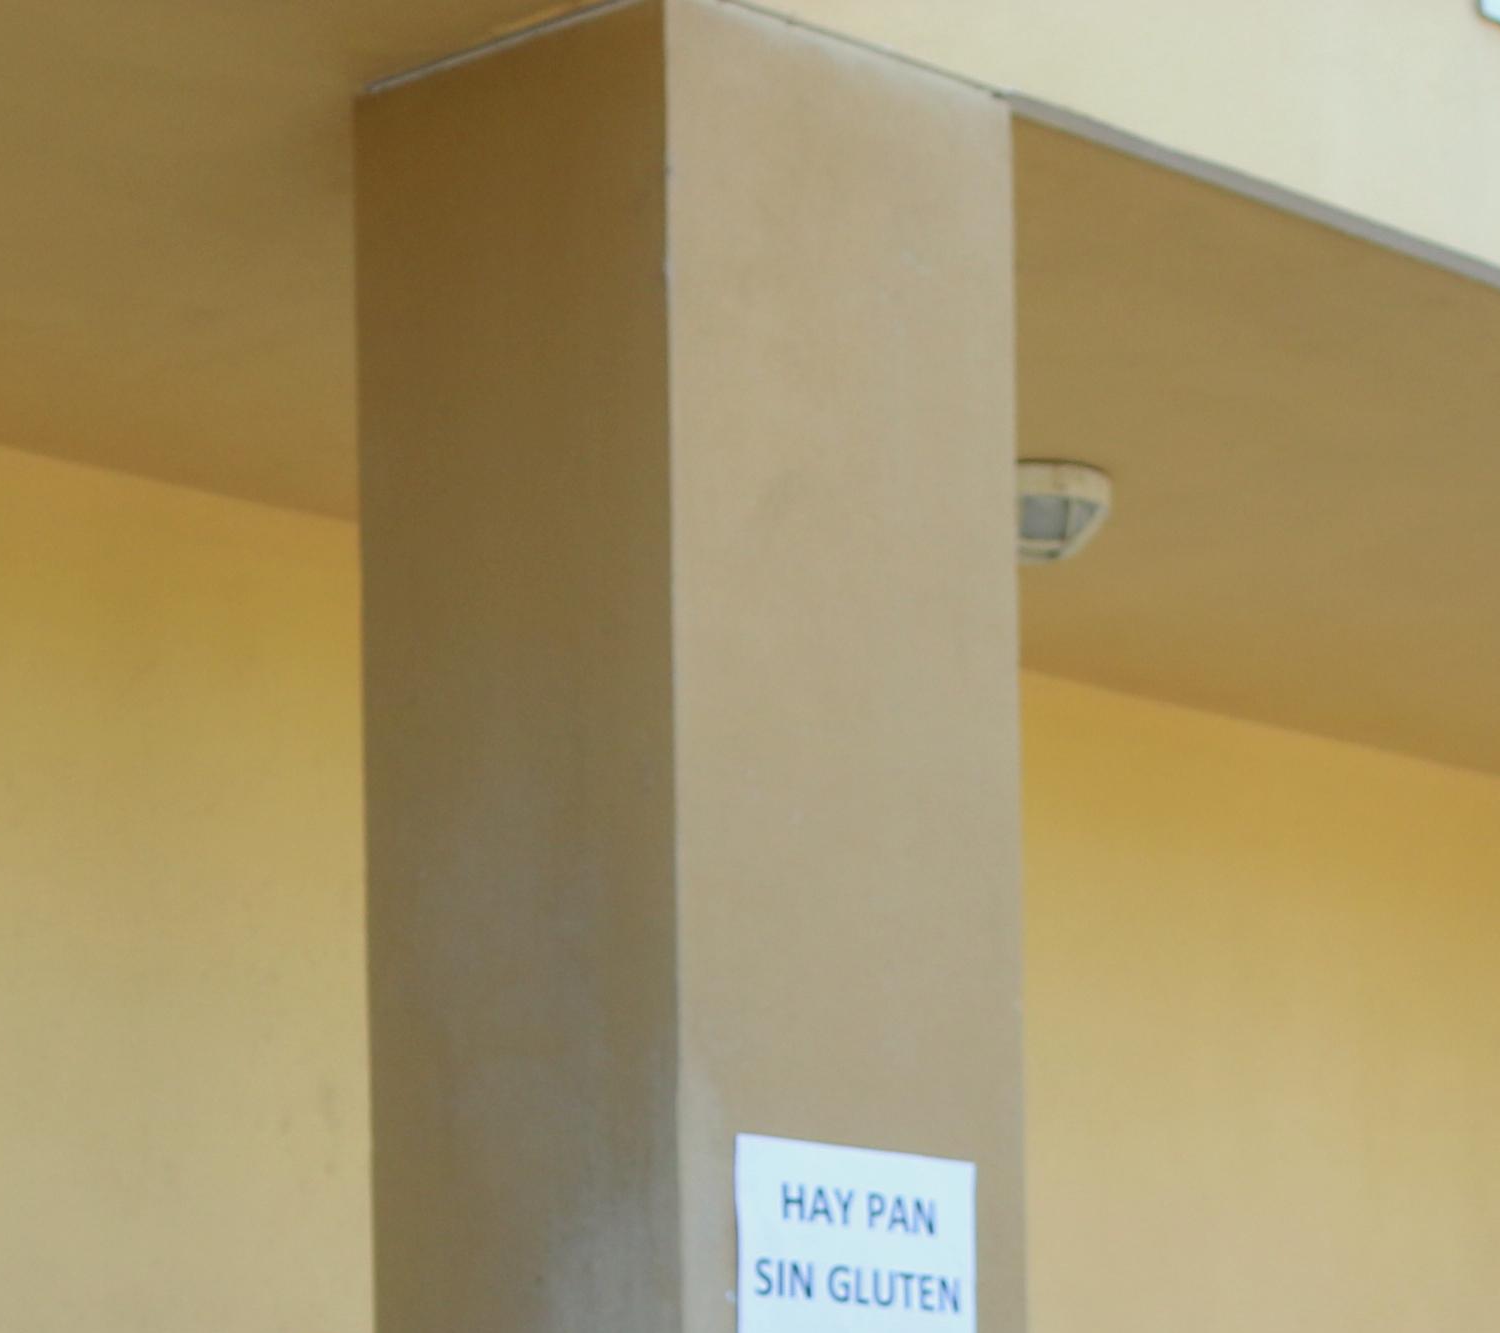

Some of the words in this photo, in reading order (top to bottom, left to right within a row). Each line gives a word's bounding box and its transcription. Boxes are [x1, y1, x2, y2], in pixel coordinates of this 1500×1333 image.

[781, 1182, 854, 1226] HAY
[867, 1191, 936, 1236] PAN
[754, 1257, 814, 1300] SIN
[827, 1264, 961, 1314] GLUTEN
